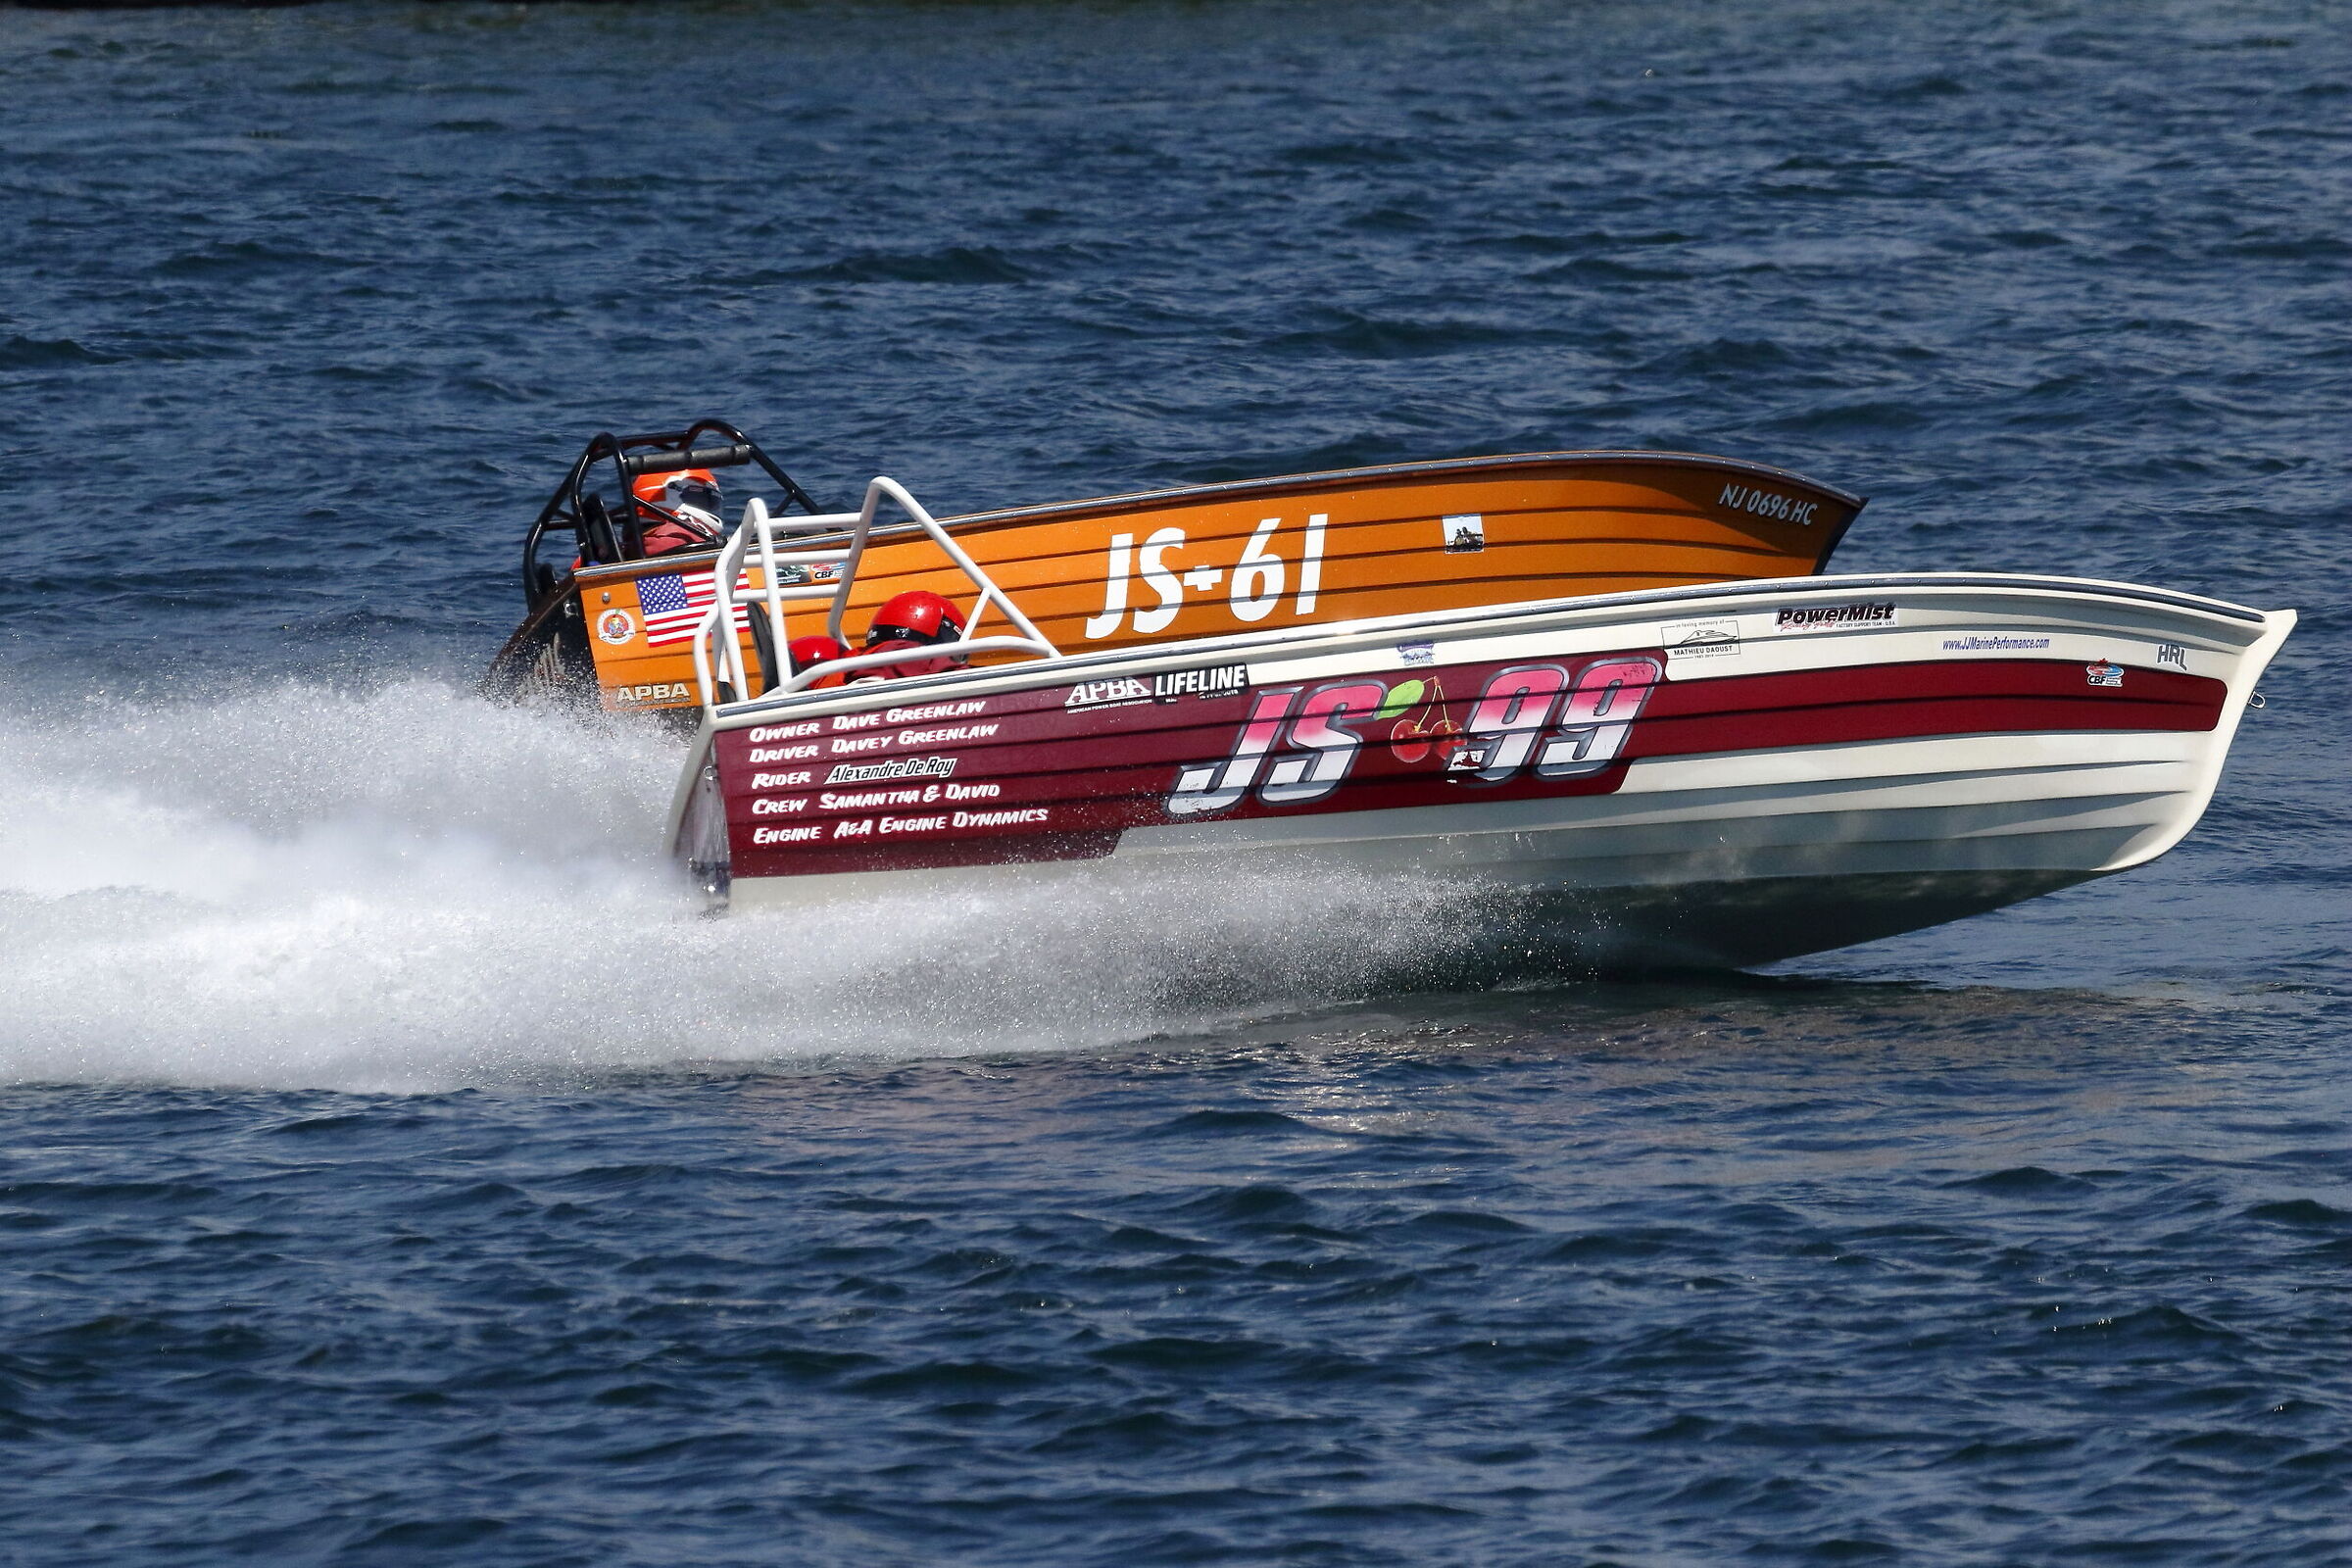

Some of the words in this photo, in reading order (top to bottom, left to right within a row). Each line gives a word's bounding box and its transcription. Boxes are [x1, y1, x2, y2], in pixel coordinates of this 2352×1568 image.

[1718, 482, 1747, 509] NJ
[1746, 489, 1792, 519] 0696
[1788, 500, 1818, 525] HC
[814, 570, 834, 579] CBF
[1705, 645, 1733, 654] DAOUST
[1942, 636, 2050, 650] www.JJMarinePerformance.com
[2157, 644, 2187, 671] HRL
[616, 682, 691, 702] APBA
[1064, 676, 1152, 705] APBA
[1154, 664, 1246, 697] LIFELINE
[2088, 675, 2106, 684] CBF
[749, 722, 820, 743] OWNER
[833, 712, 880, 730] DAVE
[886, 701, 986, 724] GREENLAW
[749, 745, 818, 763] DRIVER
[831, 735, 892, 754] DAVEY
[898, 723, 999, 746] GREENLAW
[1164, 680, 1388, 815] JS
[1447, 660, 1661, 787] 99
[752, 770, 811, 790] RIDER
[828, 762, 904, 782] Alexandre
[752, 798, 808, 815] CREW
[818, 788, 920, 810] SAMANTHA
[923, 784, 941, 803] &
[945, 783, 1001, 801] DAVID
[753, 826, 822, 845] ENGINE
[833, 818, 873, 840] A&A
[879, 815, 948, 835] ENGINE
[953, 808, 1050, 828] DYNAMICS
